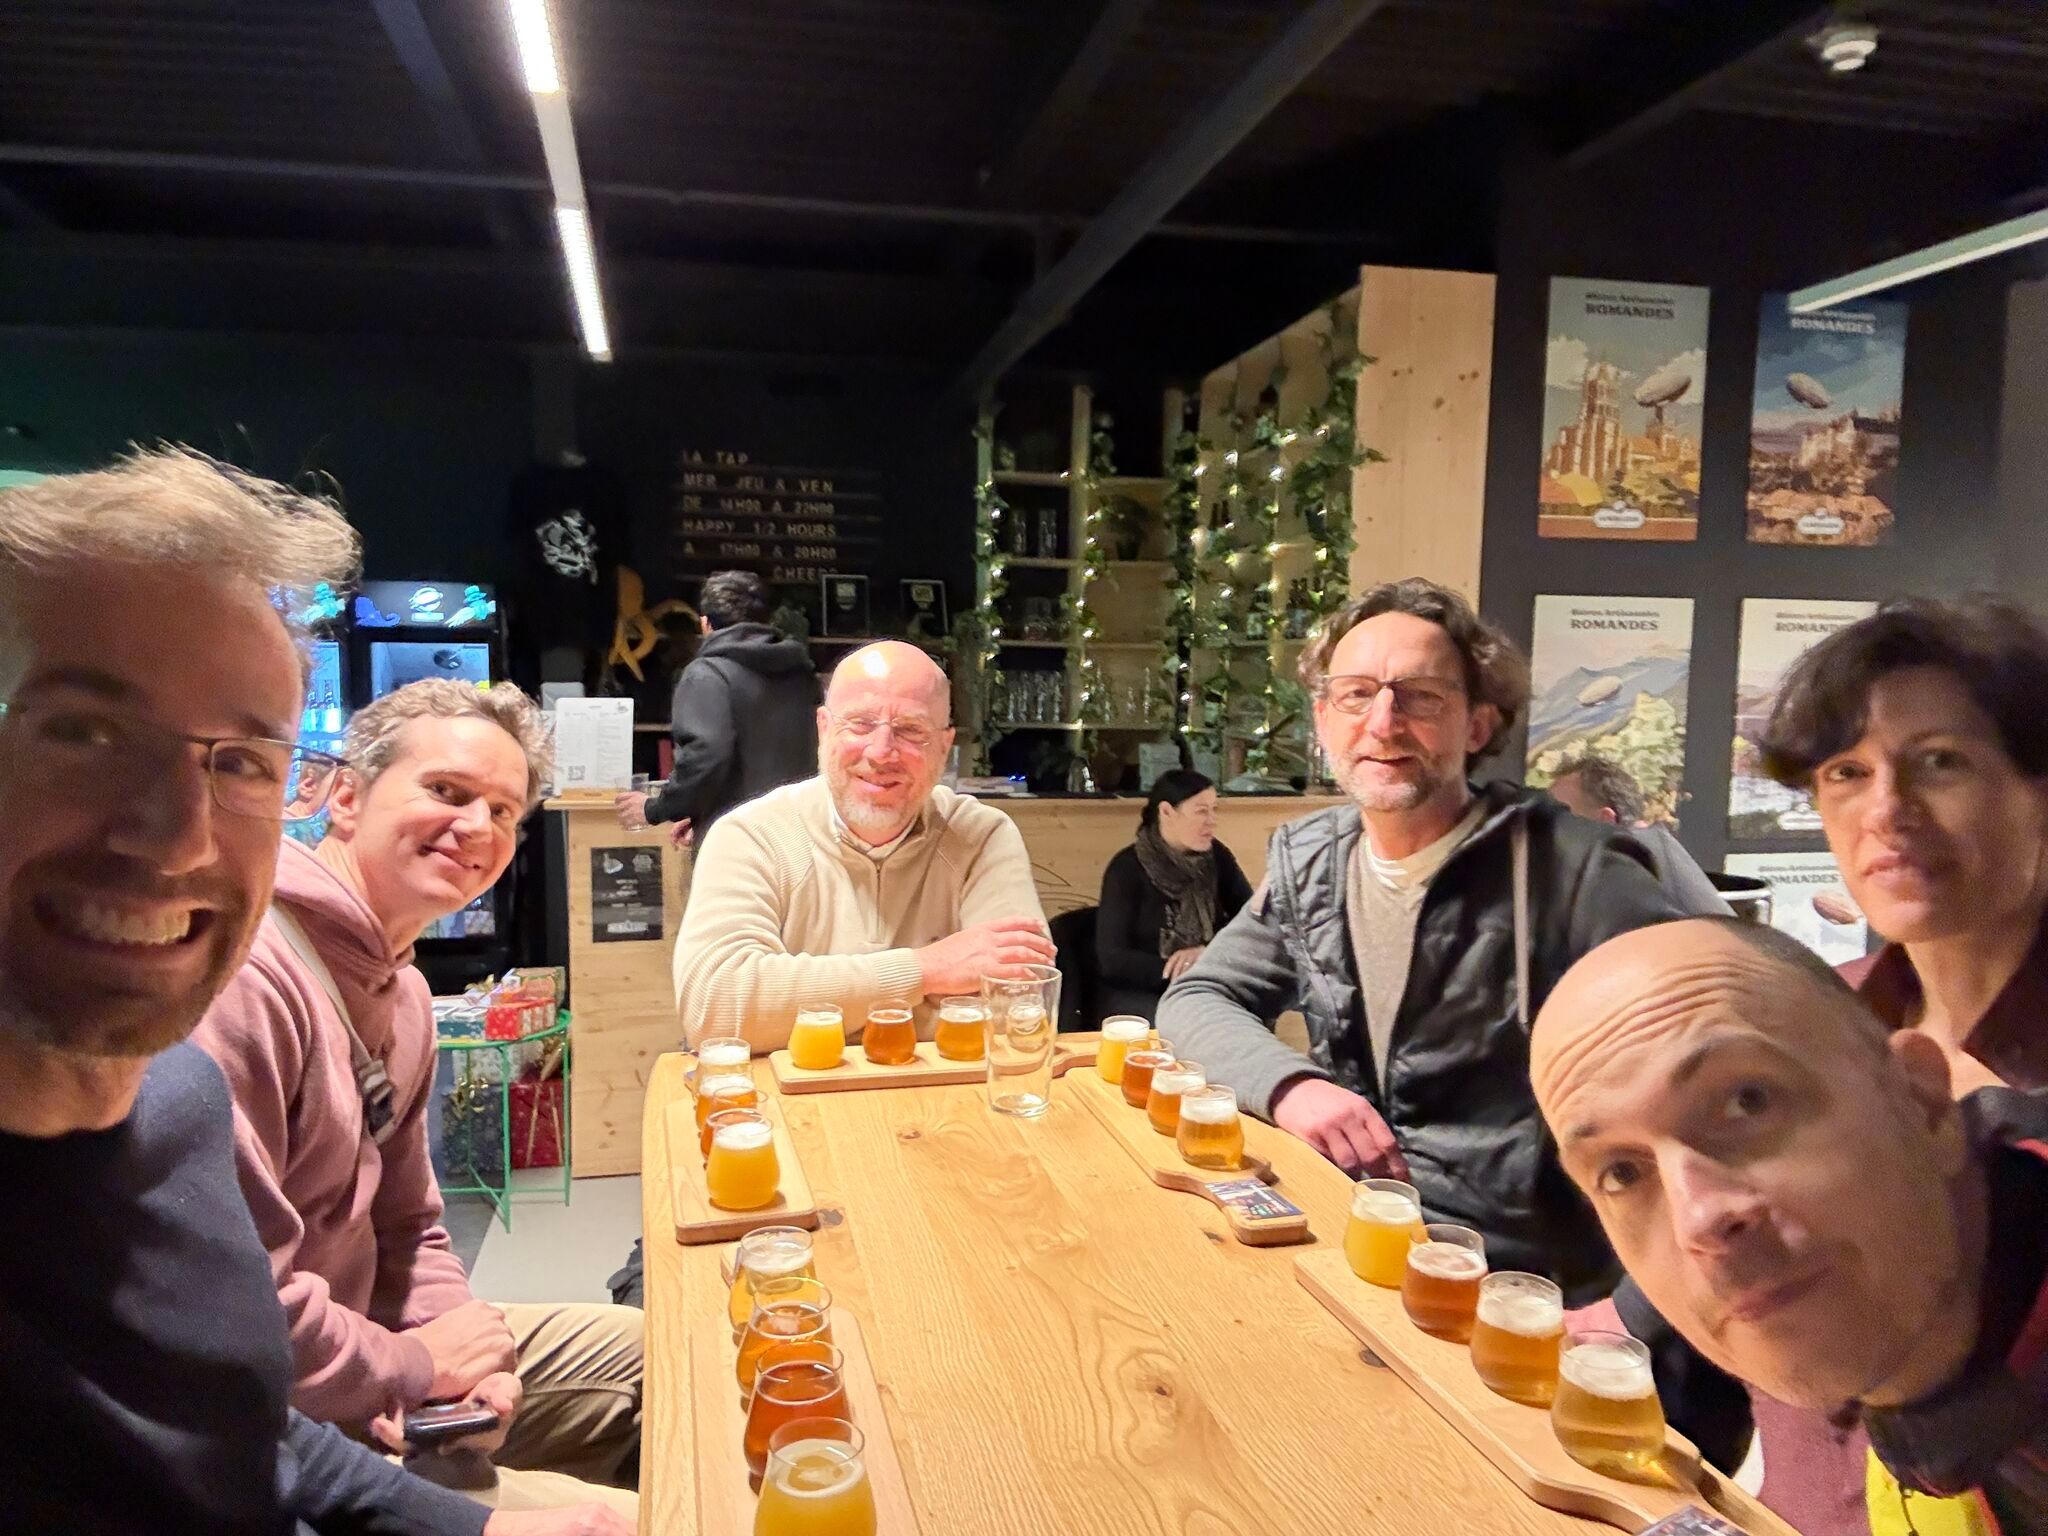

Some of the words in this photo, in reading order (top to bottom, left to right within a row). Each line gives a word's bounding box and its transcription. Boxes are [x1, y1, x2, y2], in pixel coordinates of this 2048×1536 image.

[1585, 303, 1674, 319] ROMANDES
[800, 480, 833, 494] VEN
[683, 519, 734, 535] HAPPY
[787, 524, 836, 538] HOURS
[1570, 618, 1659, 631] ROMANDES
